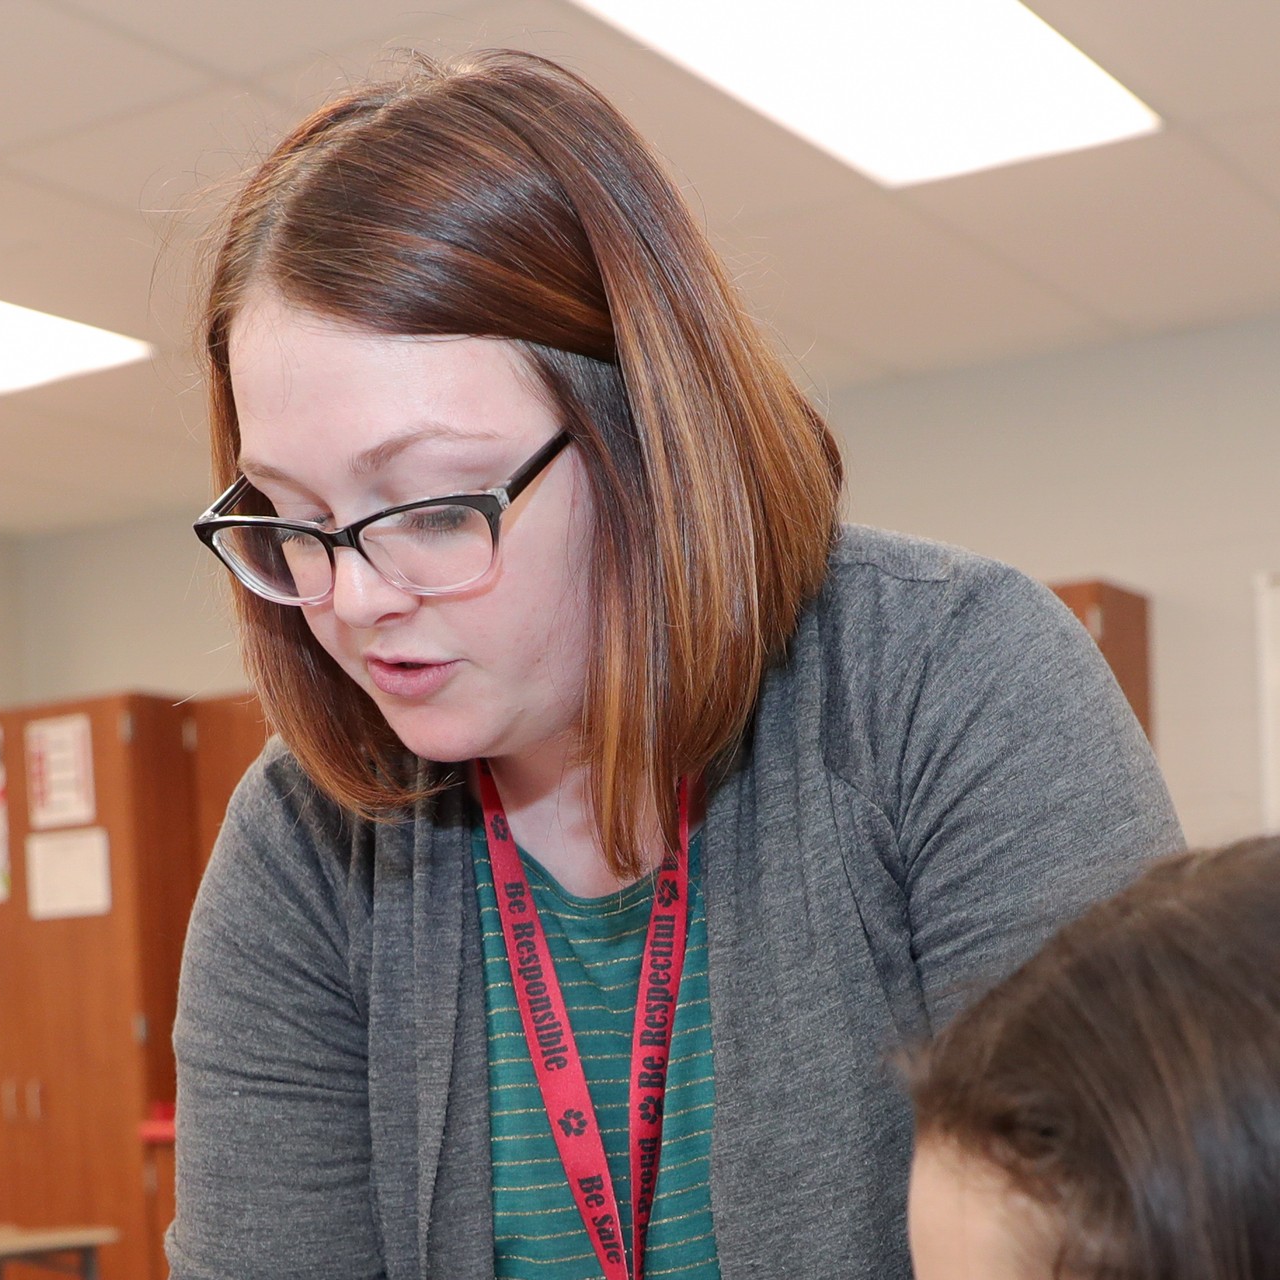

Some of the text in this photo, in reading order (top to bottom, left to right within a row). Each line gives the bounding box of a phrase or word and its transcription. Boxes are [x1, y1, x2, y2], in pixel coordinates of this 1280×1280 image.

[504, 882, 569, 1071] Be Responsible
[638, 914, 676, 1088] Be Respectful
[577, 1173, 621, 1264] Be Safe
